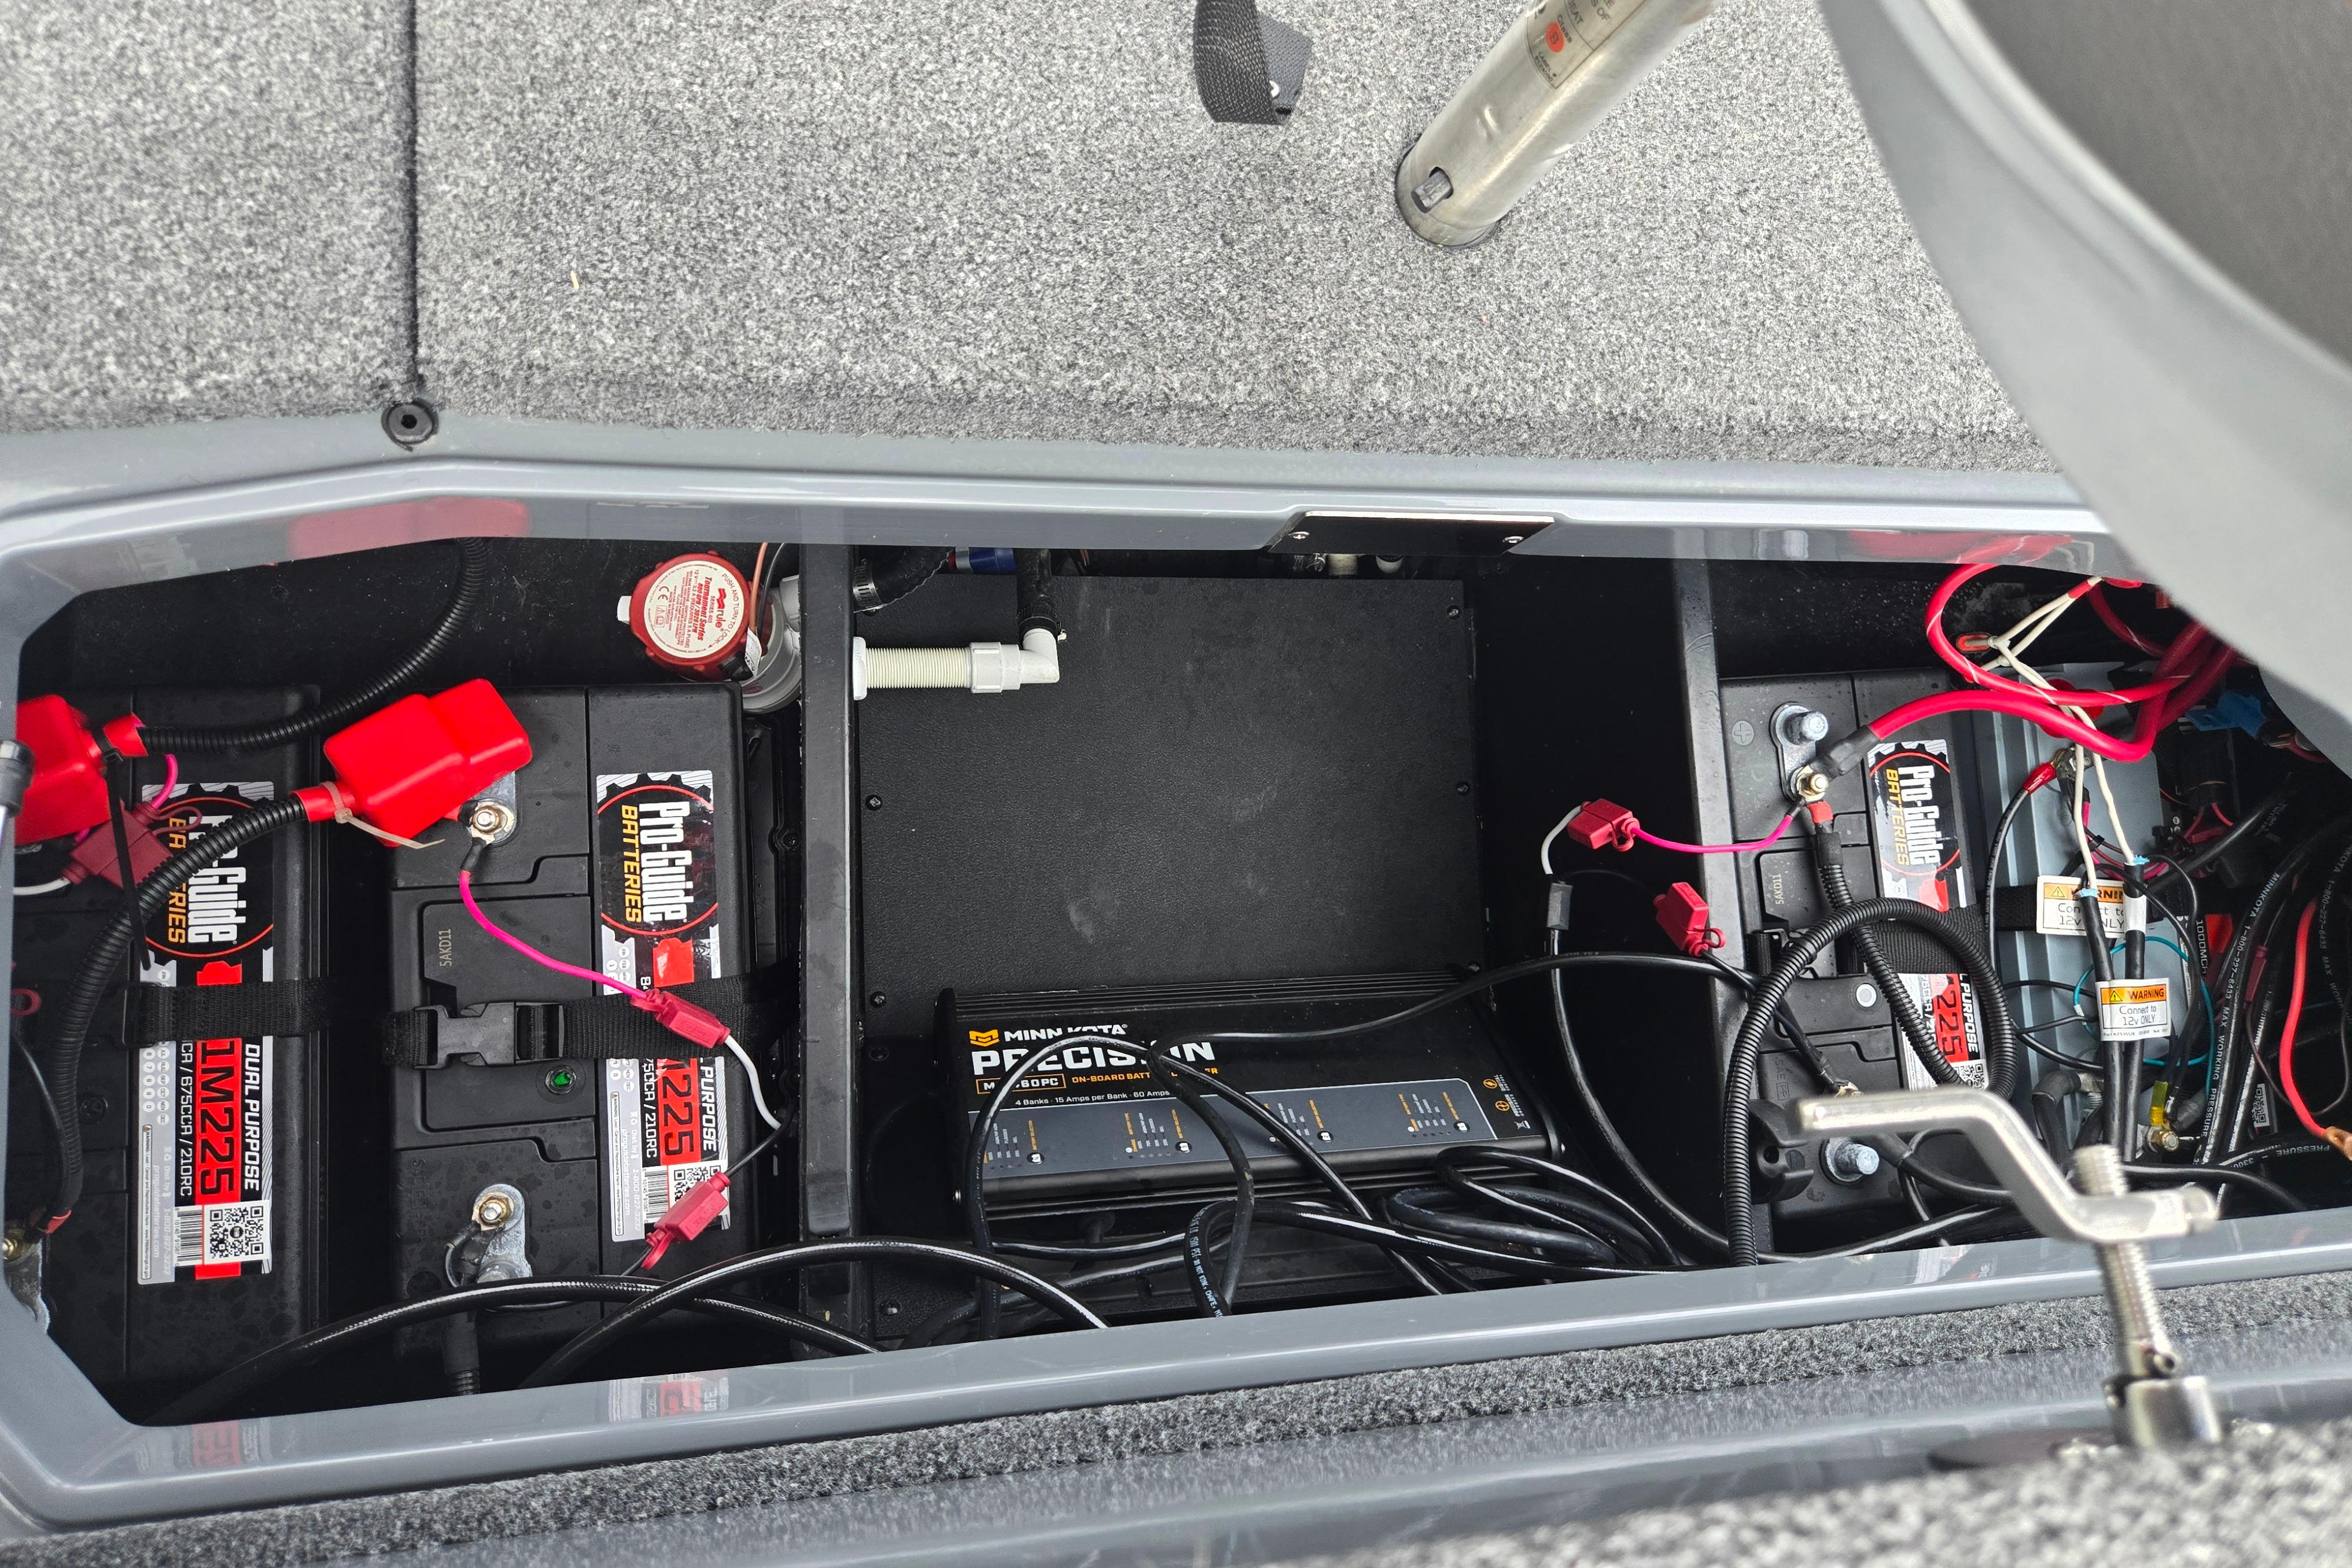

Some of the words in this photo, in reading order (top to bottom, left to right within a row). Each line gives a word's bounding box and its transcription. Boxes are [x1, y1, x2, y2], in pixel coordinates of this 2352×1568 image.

[1558, 15, 1572, 43] Class
[700, 577, 713, 618] Tournament
[721, 574, 735, 588] PUSH
[697, 618, 707, 641] Series
[714, 628, 730, 643] LOCK
[716, 610, 726, 628] rule
[727, 621, 735, 629] TO
[1886, 768, 1909, 865] BATTERIES
[1898, 765, 1943, 865] Pro-Guide
[188, 815, 246, 942] P-Guide
[622, 805, 641, 922] BATTERIES
[640, 801, 694, 921] Pro-Guide
[168, 817, 186, 943] BARIES
[1772, 874, 1784, 904] 5AKD11
[2249, 872, 2280, 918] MINNKOTA
[2059, 903, 2108, 915] Cont
[2103, 918, 2124, 928] NLY
[439, 929, 452, 966] 5AKD11
[2225, 925, 2251, 999] 1-800-227-6433
[2119, 1005, 2149, 1014] Connect
[2127, 988, 2164, 999] WARNING
[1004, 1028, 1063, 1042] MINN
[1937, 976, 1963, 1057] 225
[1960, 982, 1979, 1053] PURPOSE
[2122, 1017, 2139, 1025] 12v
[2140, 1014, 2155, 1025] ONLY
[2219, 1007, 2230, 1028] MAX
[181, 1041, 193, 1063] CA
[245, 1044, 260, 1095] DUAL
[971, 1041, 1215, 1075] PRECISN
[2212, 1034, 2224, 1081] WORKING
[1071, 1073, 1125, 1084] ON-BOARD
[1127, 1072, 1151, 1081] BATT
[181, 1076, 192, 1135] 675CCA
[700, 1065, 717, 1152] PURPOSE
[1023, 1098, 1049, 1106] Banks
[1067, 1094, 1090, 1104] Amps
[1147, 1089, 1171, 1098] Amps
[245, 1099, 260, 1191] PURPOSE
[644, 1112, 657, 1158] 210RC
[2277, 1144, 2330, 1157] PRESSURE
[181, 1148, 192, 1196] 210RC
[152, 1164, 161, 1258] proguidebatteries.com
